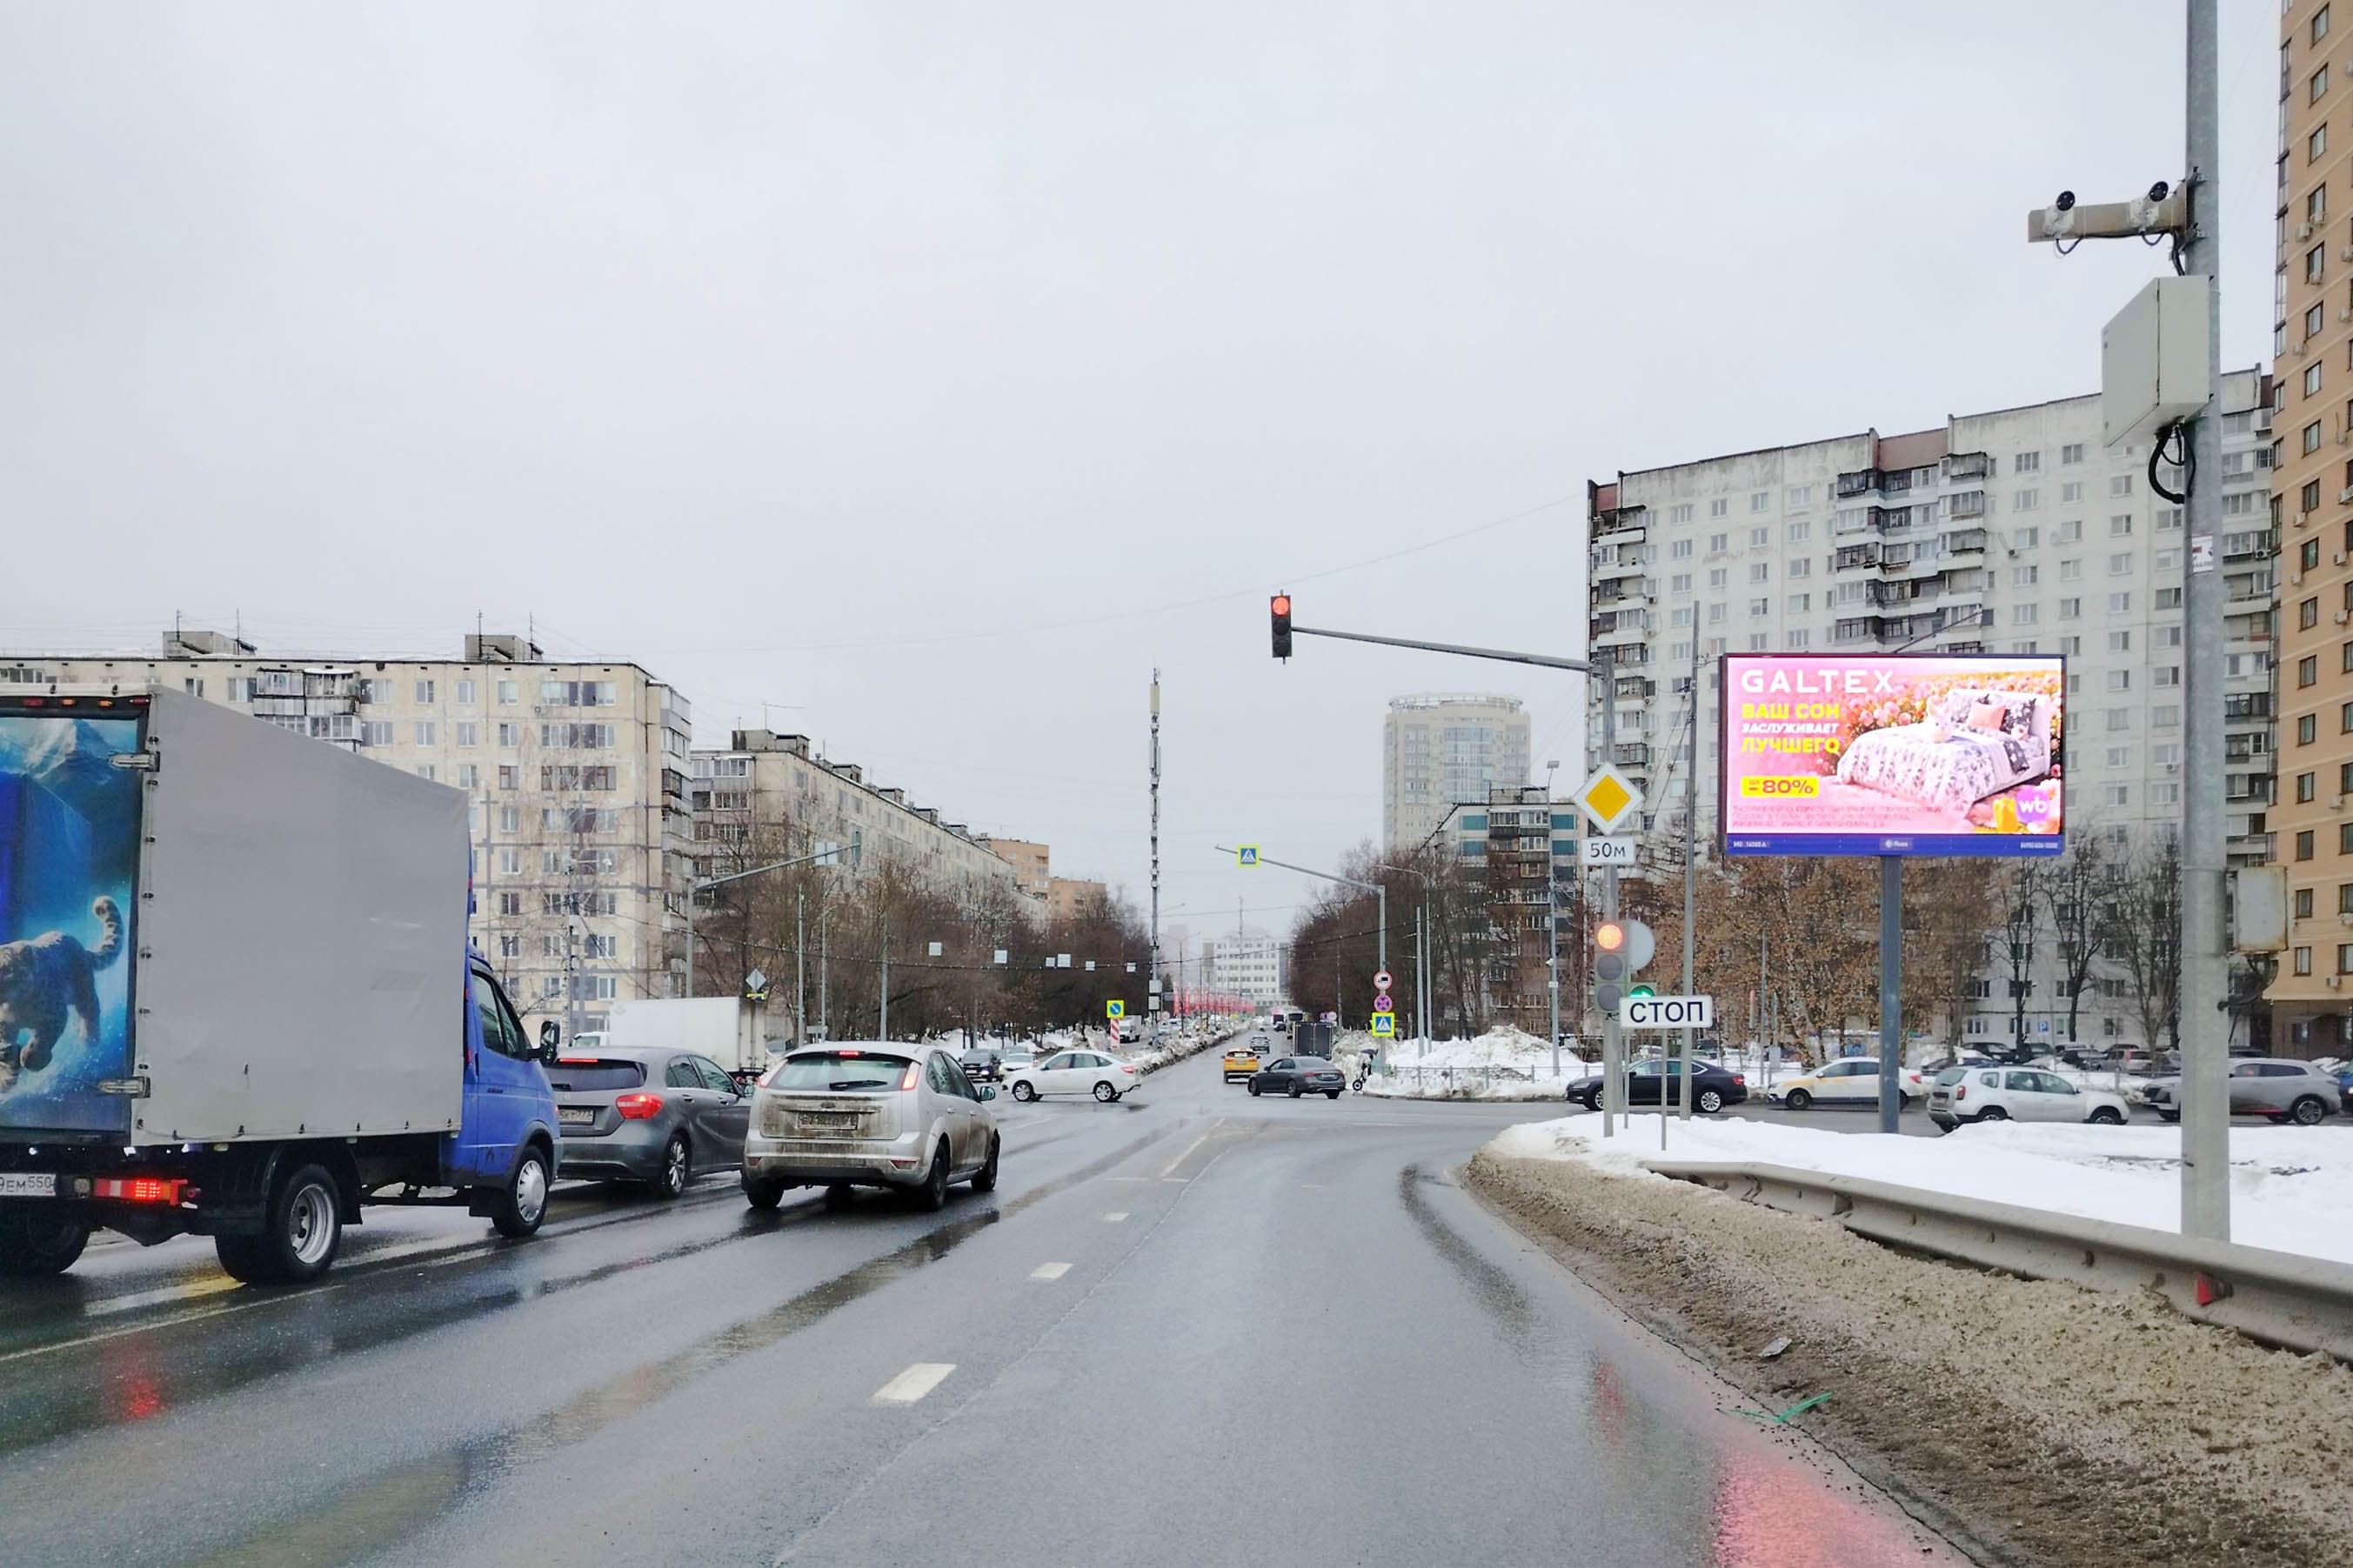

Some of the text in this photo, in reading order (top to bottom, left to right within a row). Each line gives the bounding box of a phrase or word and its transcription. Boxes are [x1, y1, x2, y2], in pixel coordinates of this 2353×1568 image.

[1741, 669, 1894, 693] GALTEX
[1741, 703, 1841, 719] ВАШ СОН
[1741, 723, 1840, 734] ЗАСЛУЖИВАЕТ
[1741, 737, 1841, 754] ЛУЧШЕГО
[2019, 794, 2049, 814] wb
[1629, 1000, 1704, 1024] СТОП
